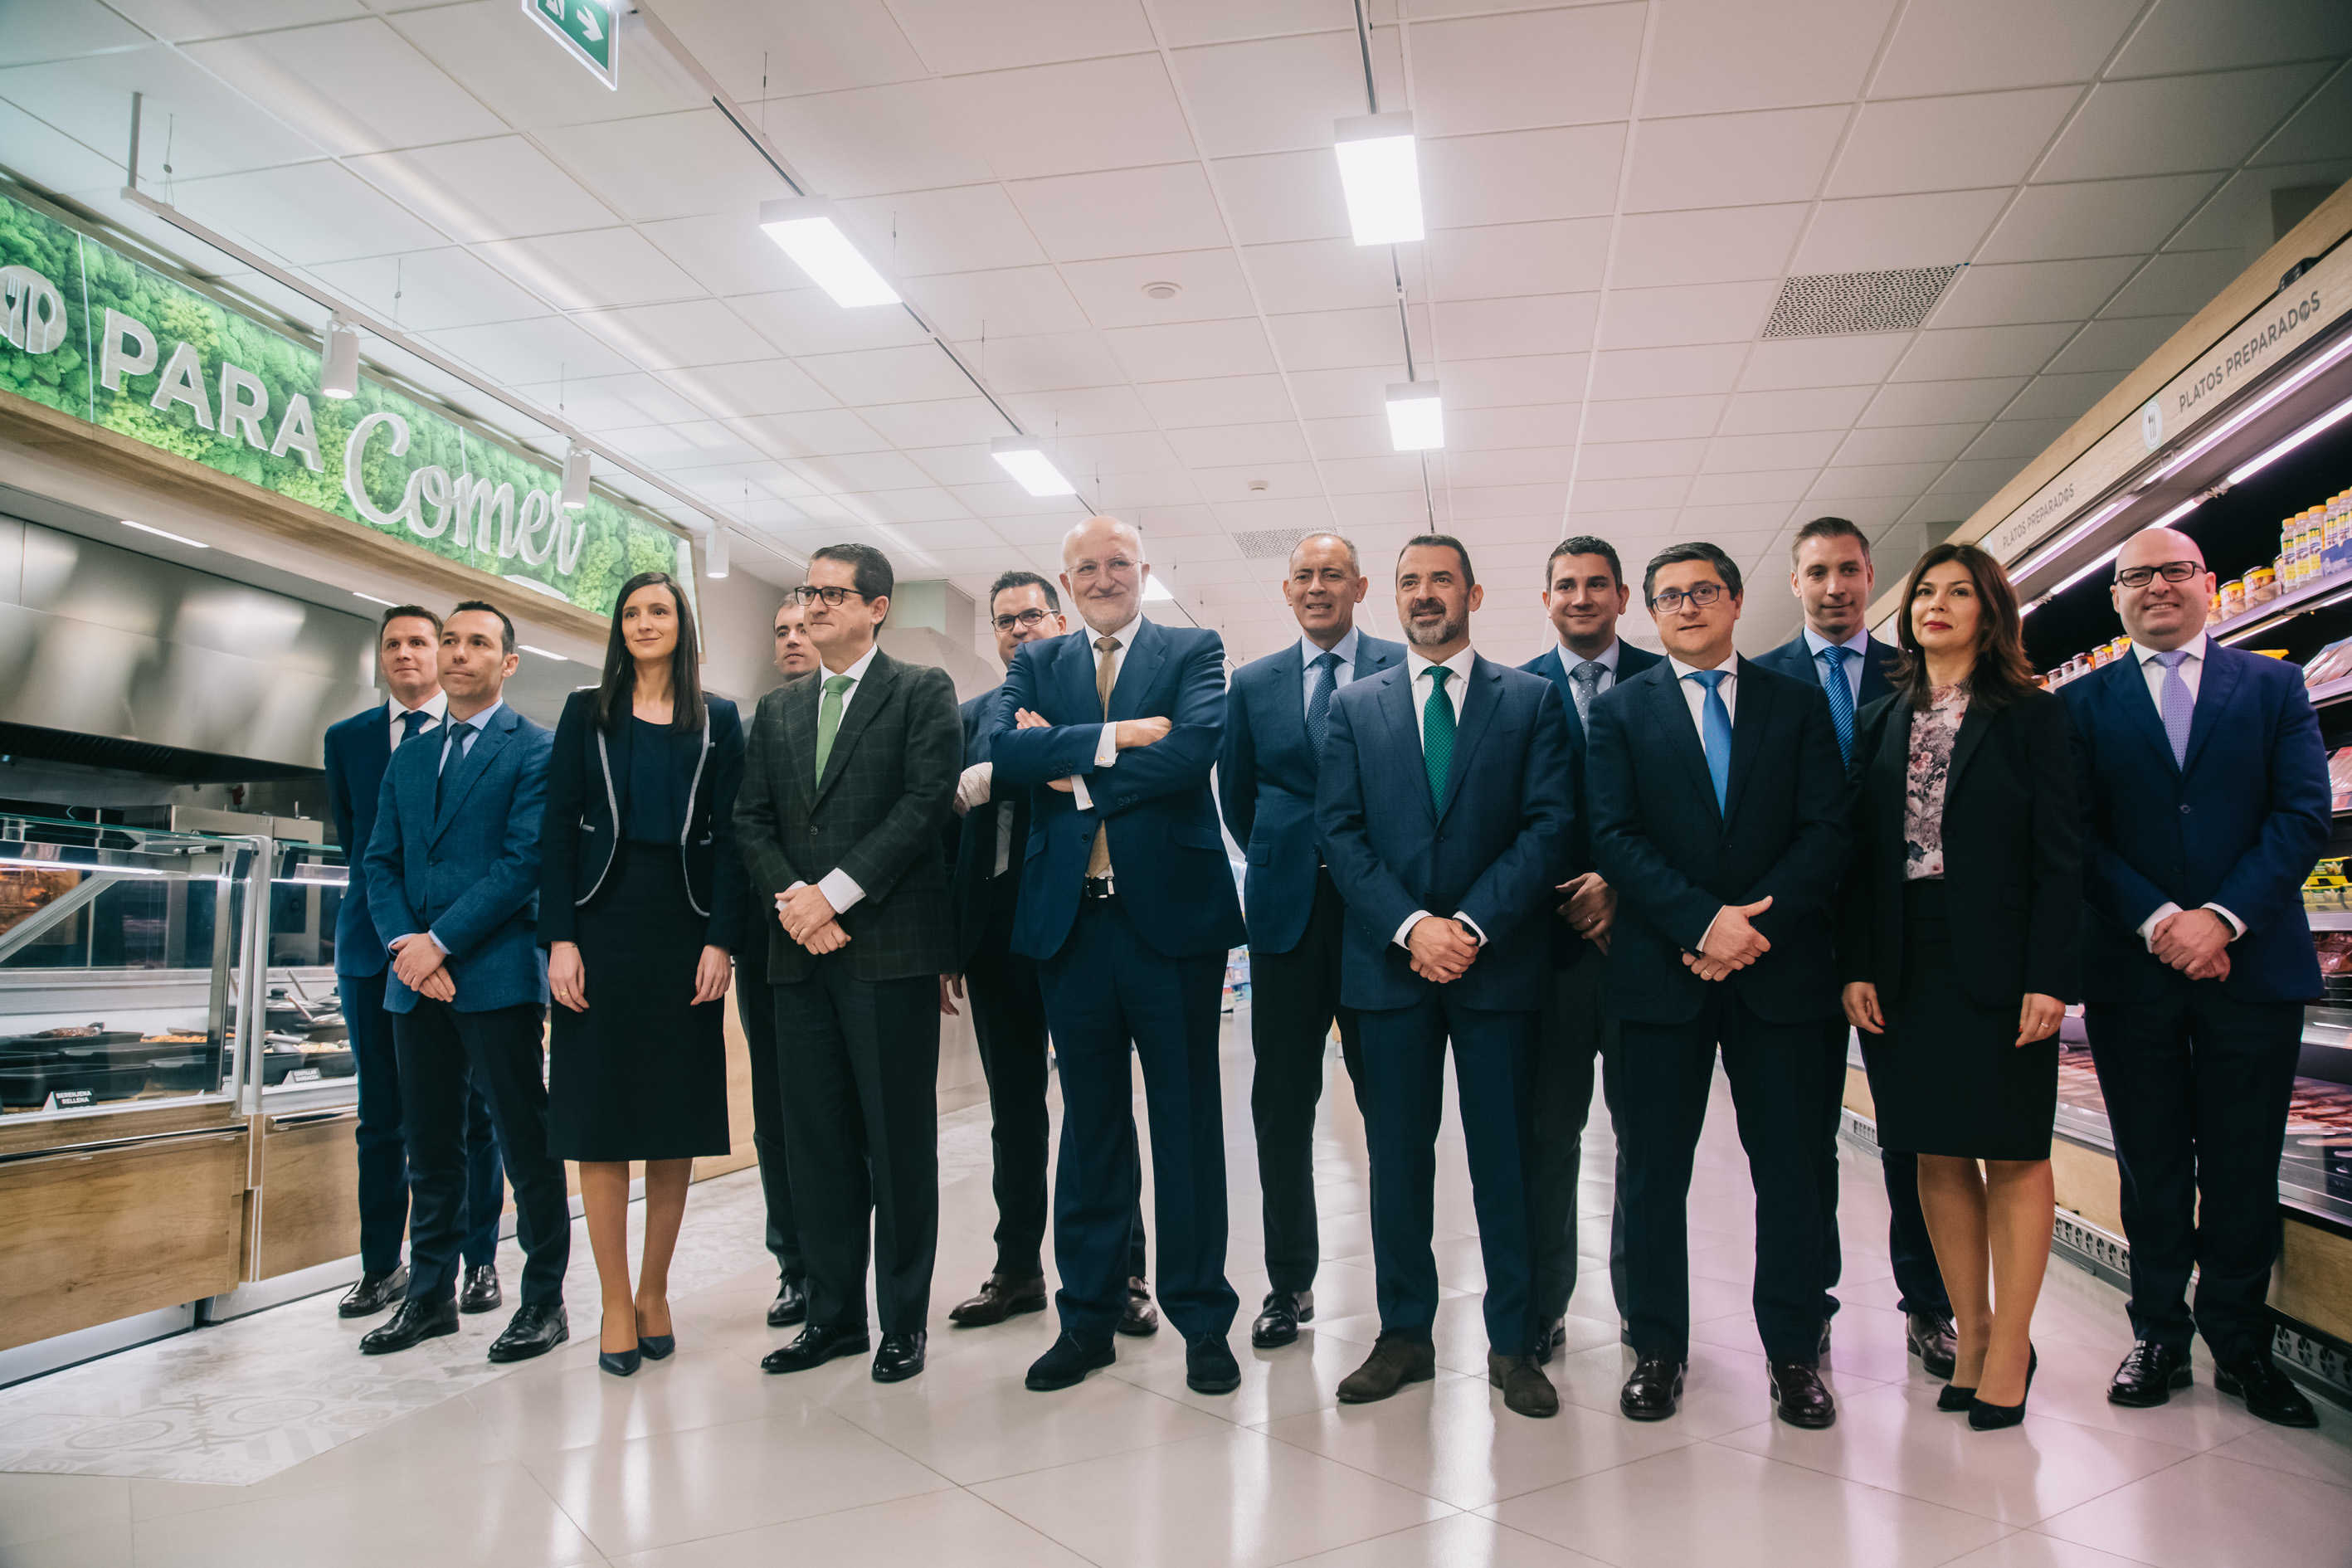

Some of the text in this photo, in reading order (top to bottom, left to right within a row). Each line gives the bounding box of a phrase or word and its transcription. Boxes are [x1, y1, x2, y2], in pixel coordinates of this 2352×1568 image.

[2179, 290, 2320, 413] PLATOS PREPARADOS
[100, 307, 586, 575] PARA Comer
[2003, 521, 2026, 548] PLATOS
